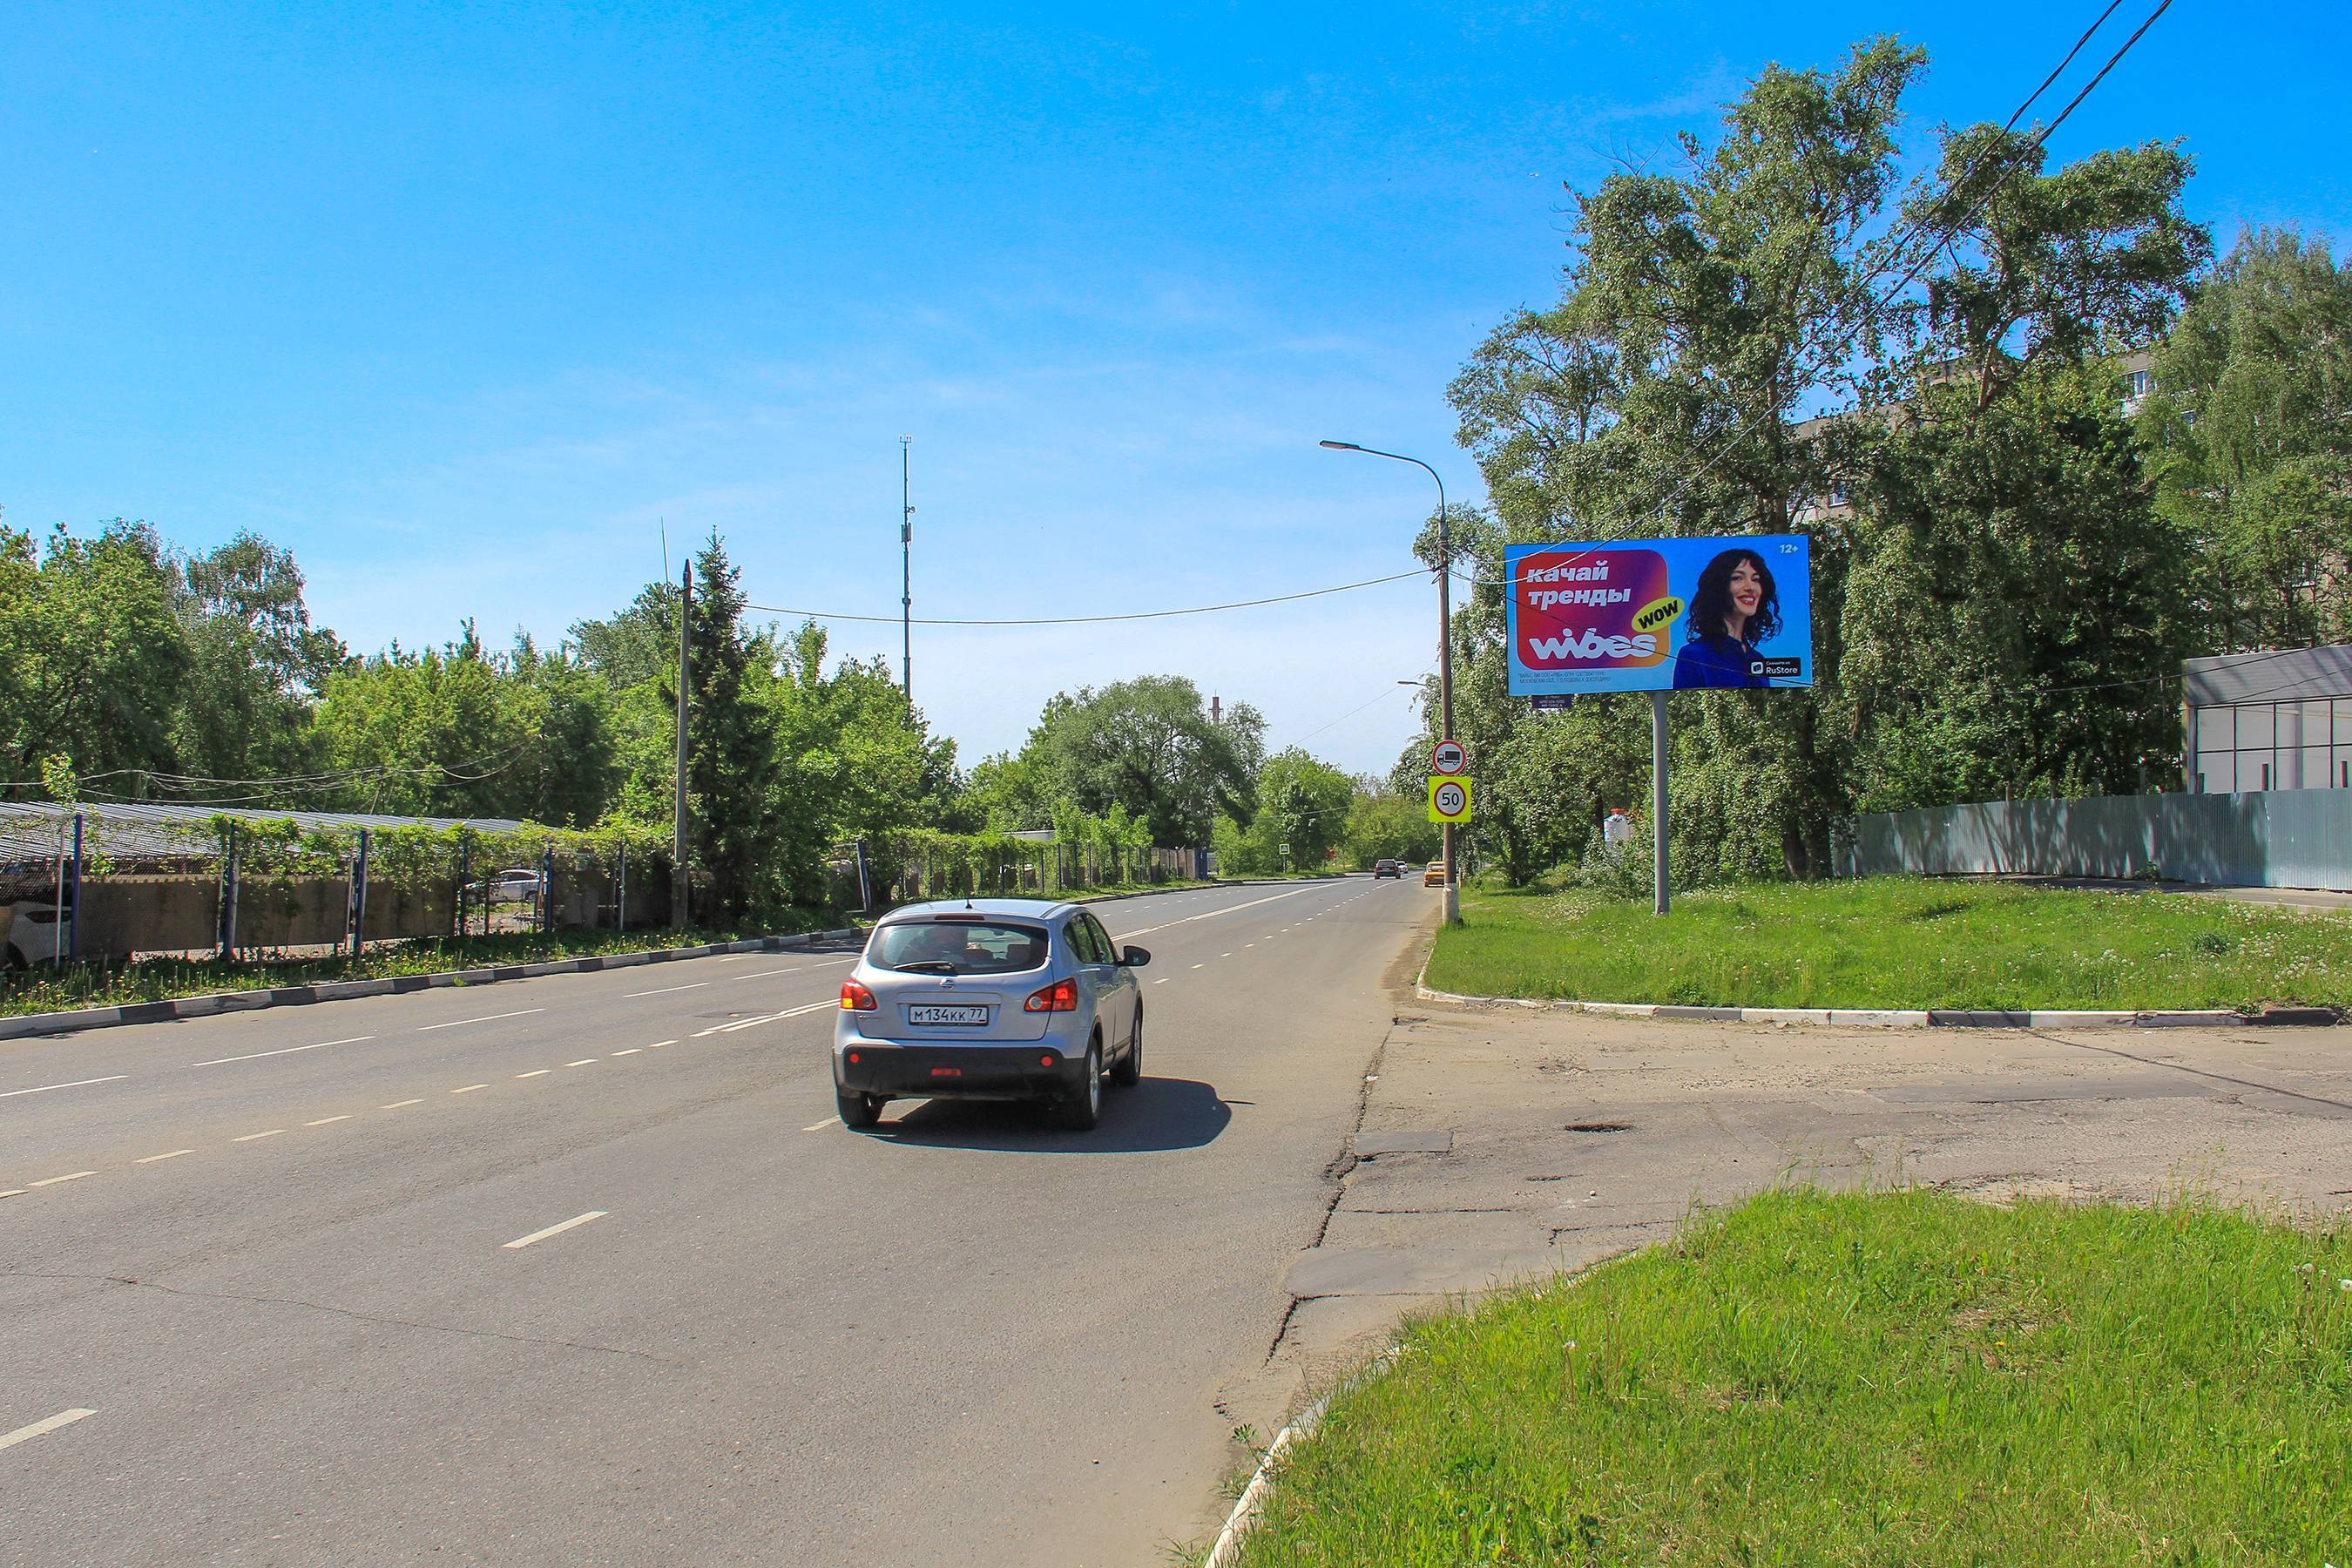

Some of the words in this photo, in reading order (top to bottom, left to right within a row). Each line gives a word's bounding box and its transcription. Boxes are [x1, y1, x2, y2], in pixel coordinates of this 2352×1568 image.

[1780, 544, 1799, 554] 12+
[1526, 560, 1609, 583] качай
[1528, 588, 1632, 611] тренды
[1442, 792, 1460, 806] 50
